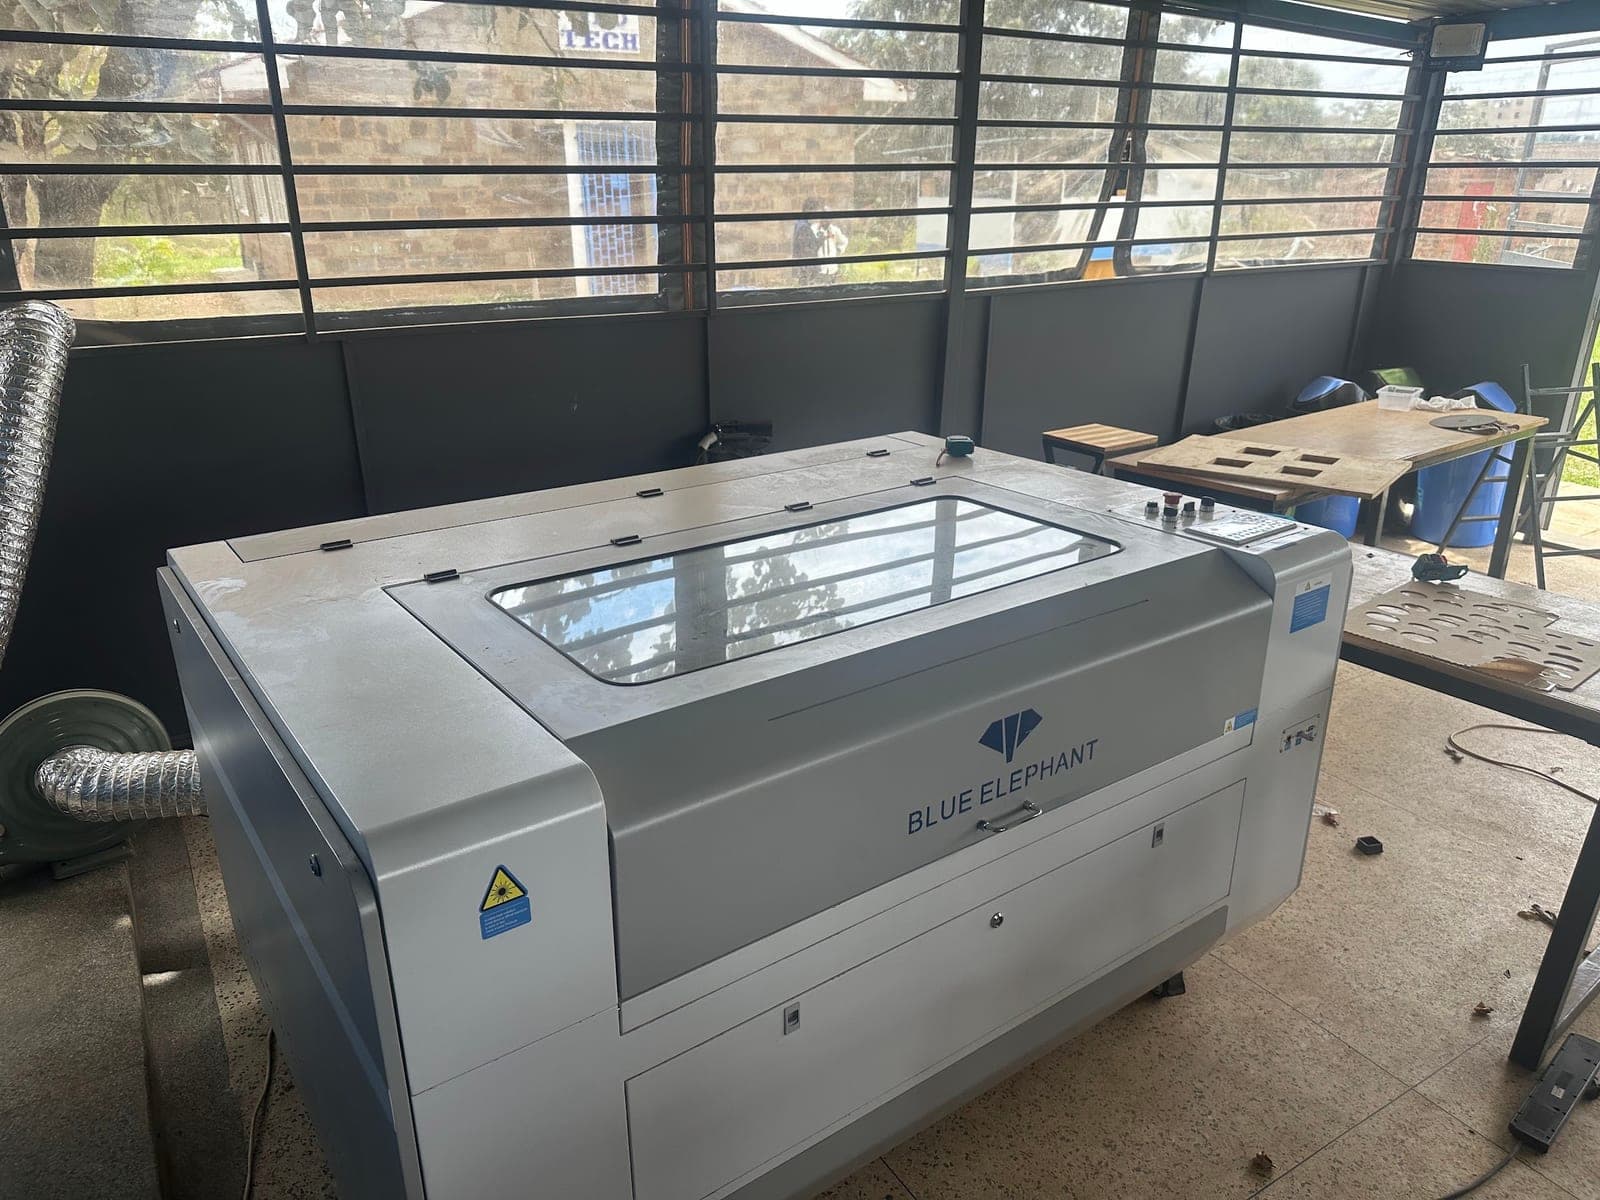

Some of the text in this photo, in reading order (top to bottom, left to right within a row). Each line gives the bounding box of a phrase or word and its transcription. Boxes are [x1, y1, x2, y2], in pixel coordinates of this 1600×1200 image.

[561, 29, 638, 51] TECH
[908, 739, 1099, 835] BLUE ELEPHANT
